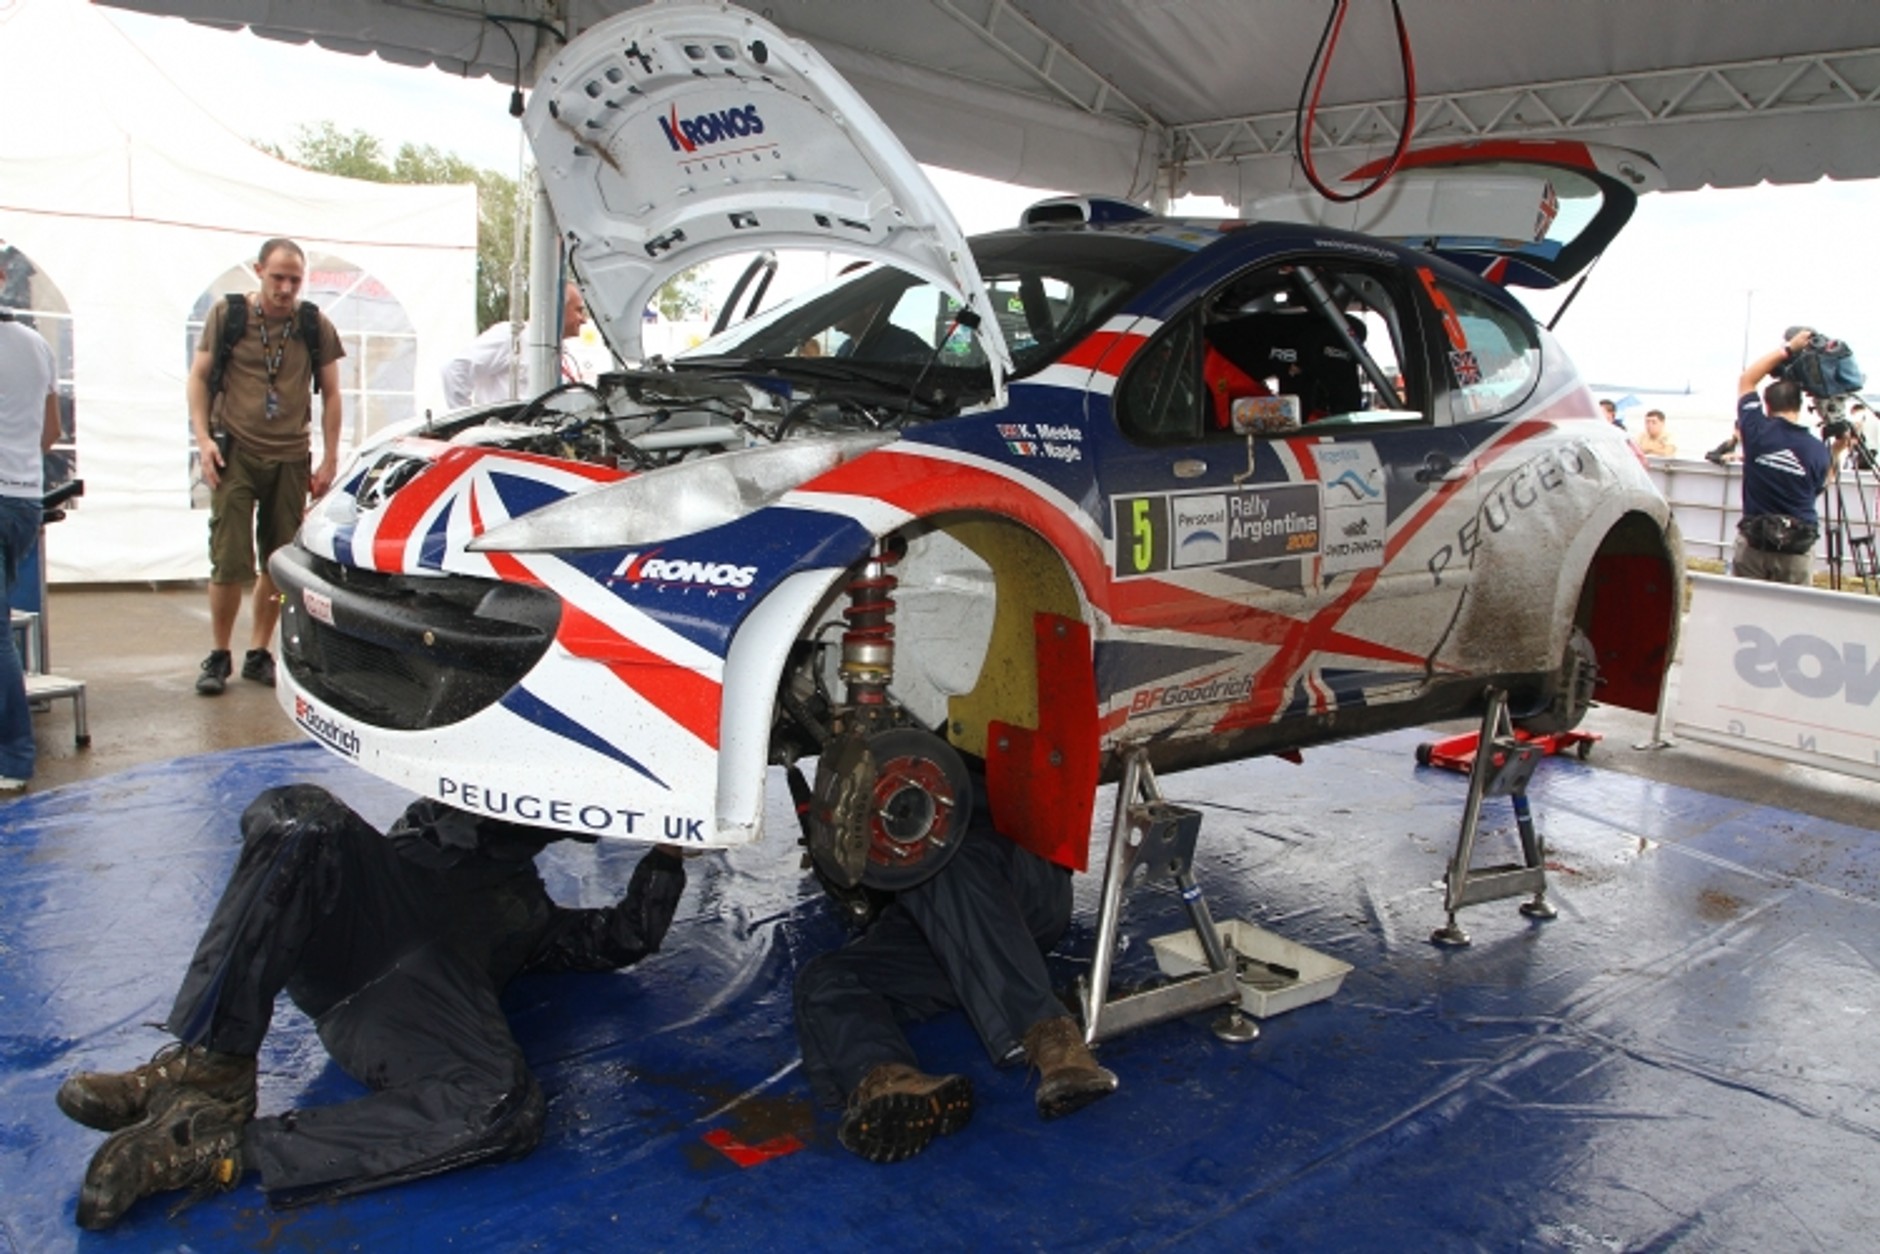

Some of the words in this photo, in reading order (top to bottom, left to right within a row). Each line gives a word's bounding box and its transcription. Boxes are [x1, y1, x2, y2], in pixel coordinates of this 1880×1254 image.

[657, 102, 765, 153] KRONOS
[1178, 510, 1225, 526] Personal
[1230, 497, 1271, 521] Rally
[1230, 512, 1318, 541] Argentina
[1427, 438, 1592, 586] PEUGEO
[1132, 498, 1152, 572] 5
[1285, 532, 1318, 550] 2010
[612, 548, 759, 588] KRONOS
[1130, 674, 1253, 713] BFGoodrich
[295, 695, 361, 754] BFGoodrich
[438, 777, 646, 834] PEUGEOT
[664, 815, 704, 842] UK
